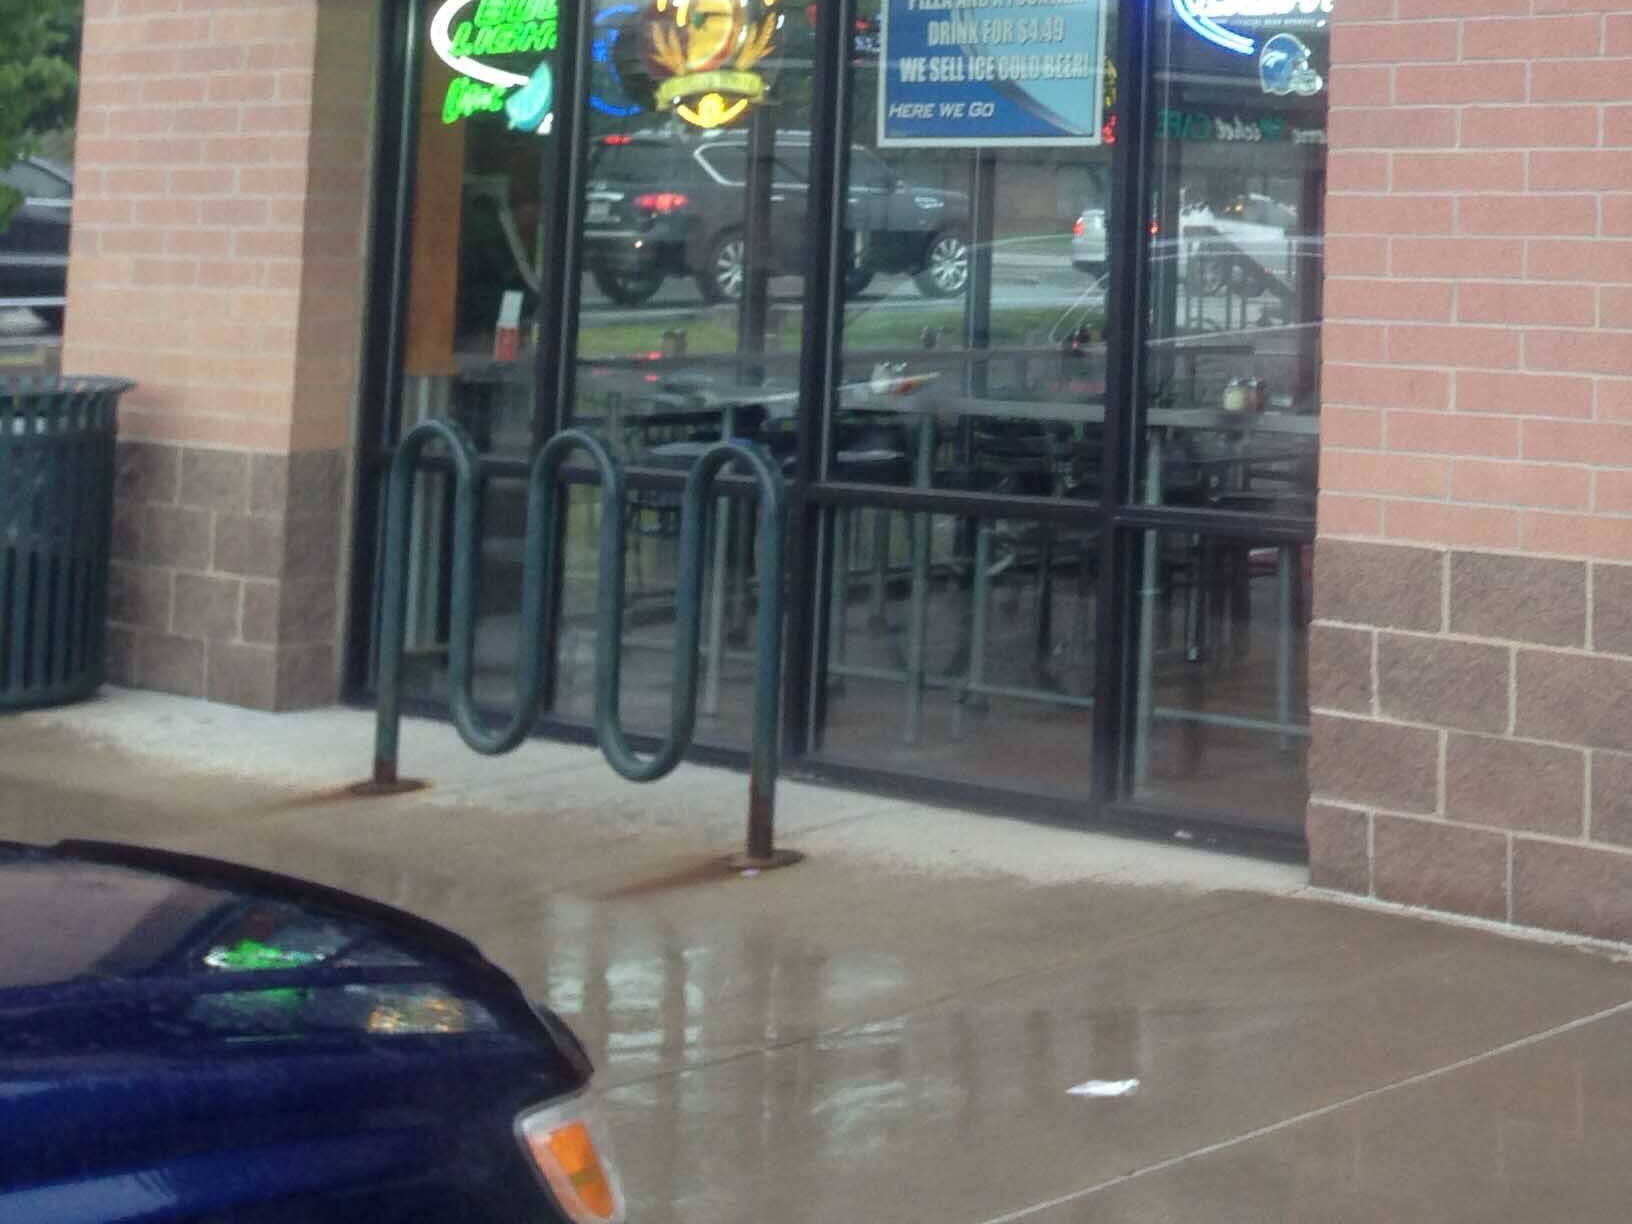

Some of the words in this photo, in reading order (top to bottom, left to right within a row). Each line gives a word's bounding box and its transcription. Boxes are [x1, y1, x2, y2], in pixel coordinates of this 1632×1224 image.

[928, 19, 977, 46] DRINK
[982, 18, 1017, 45] FOR
[900, 57, 929, 82] WE
[930, 55, 964, 82] SELL
[968, 55, 995, 81] ICE
[998, 54, 1041, 81] COLD
[1045, 52, 1089, 80] BEER!
[889, 104, 934, 120] HERE
[939, 103, 961, 119] WE
[968, 102, 995, 119] GO
